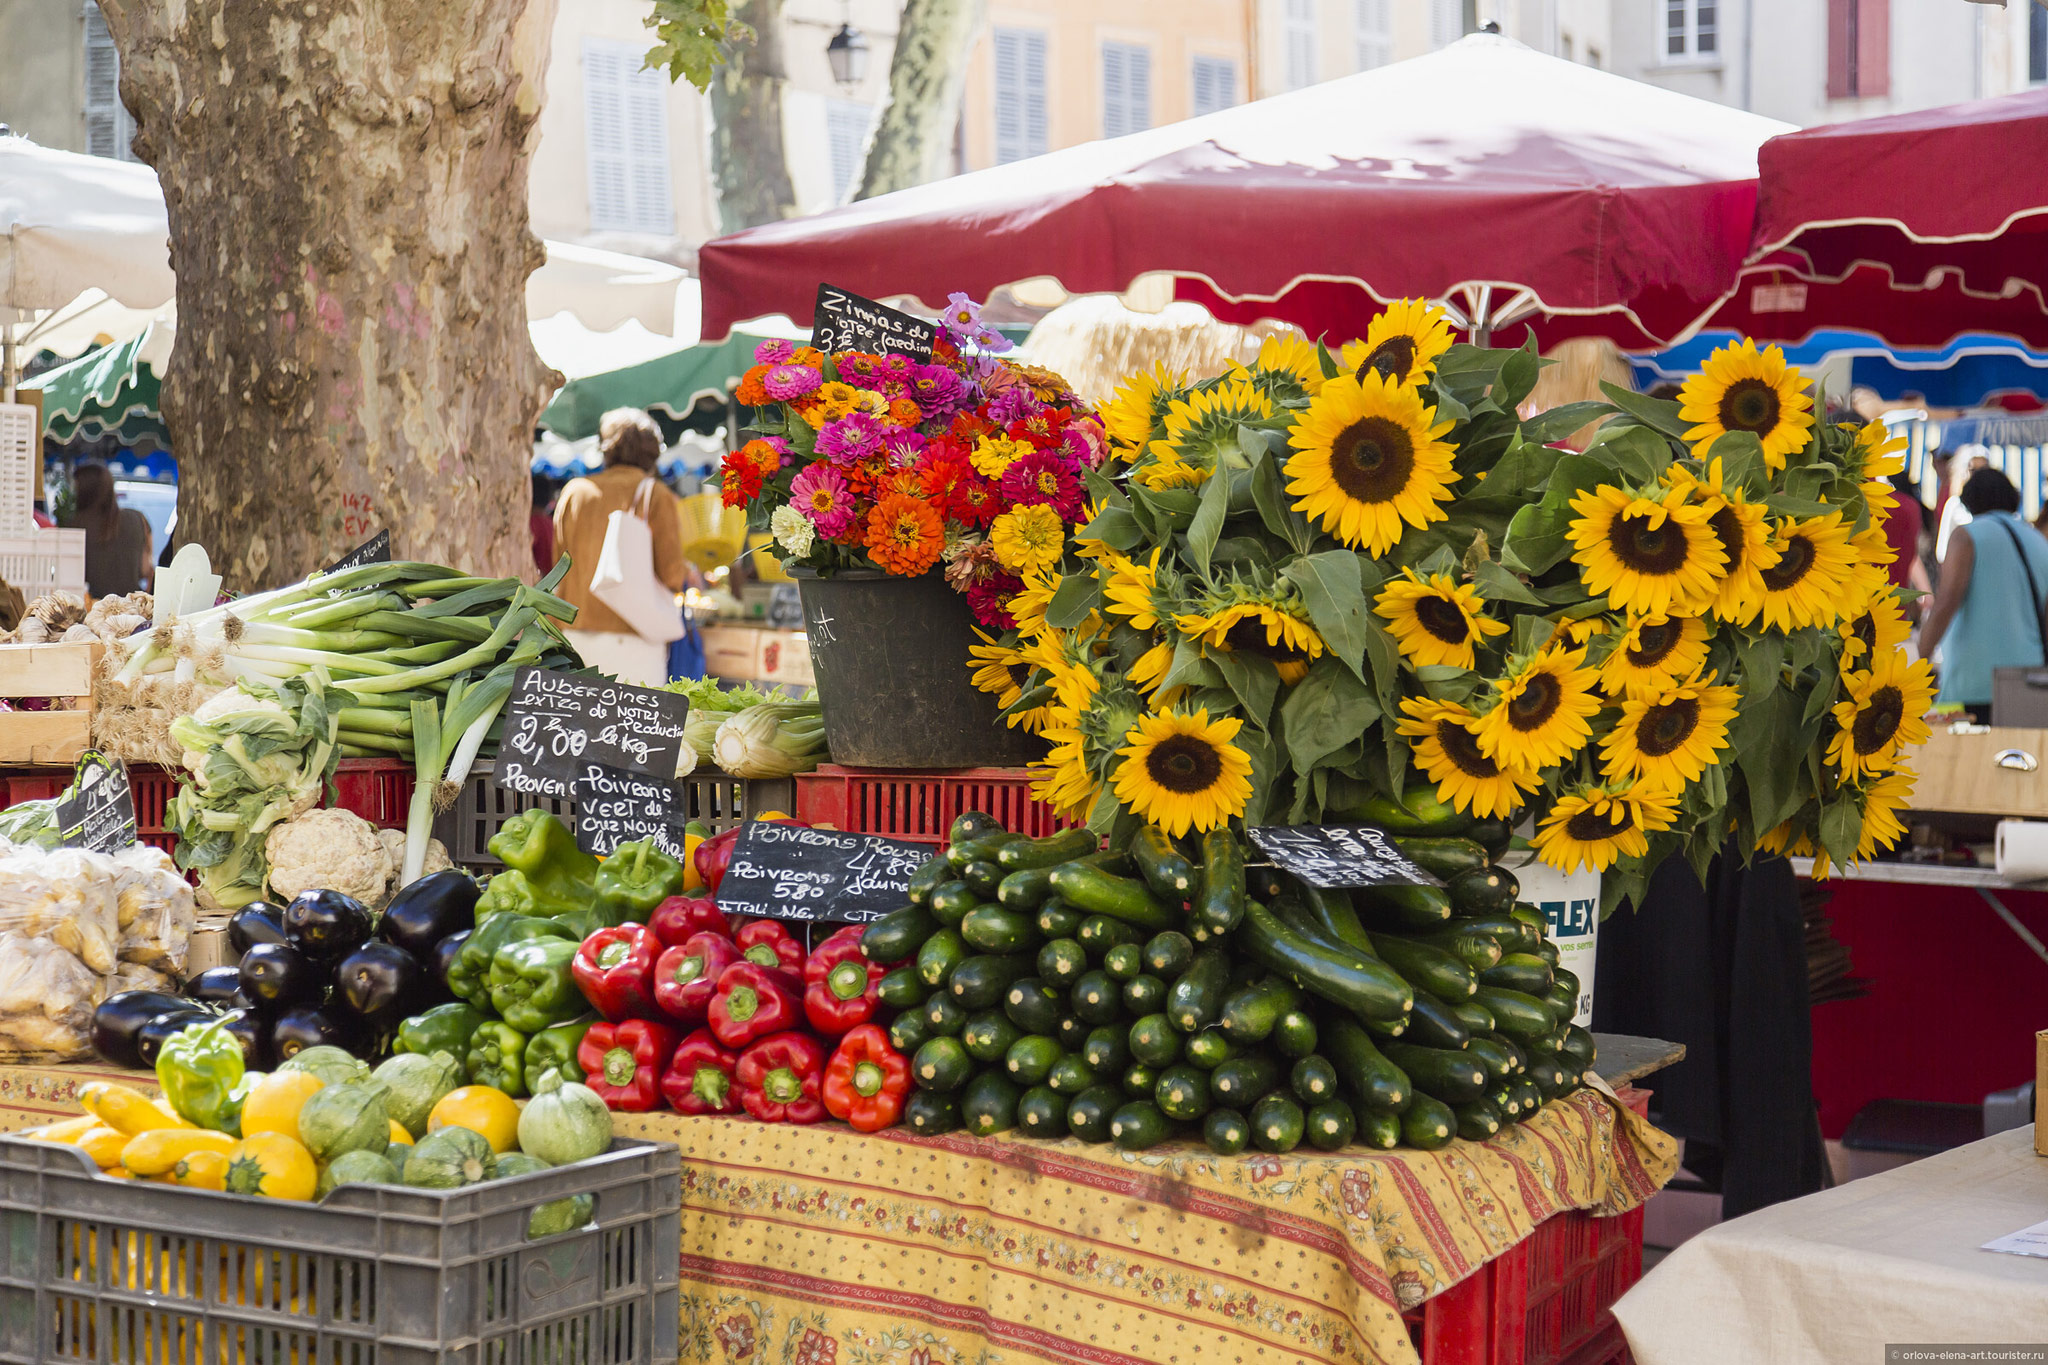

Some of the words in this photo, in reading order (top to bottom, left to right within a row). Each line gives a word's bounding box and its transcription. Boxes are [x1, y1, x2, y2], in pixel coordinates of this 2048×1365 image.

[906, 325, 929, 340] de
[588, 703, 608, 719] de
[644, 800, 662, 816] de
[1527, 898, 1596, 938] FLEX
[1580, 993, 1591, 1016] KG
